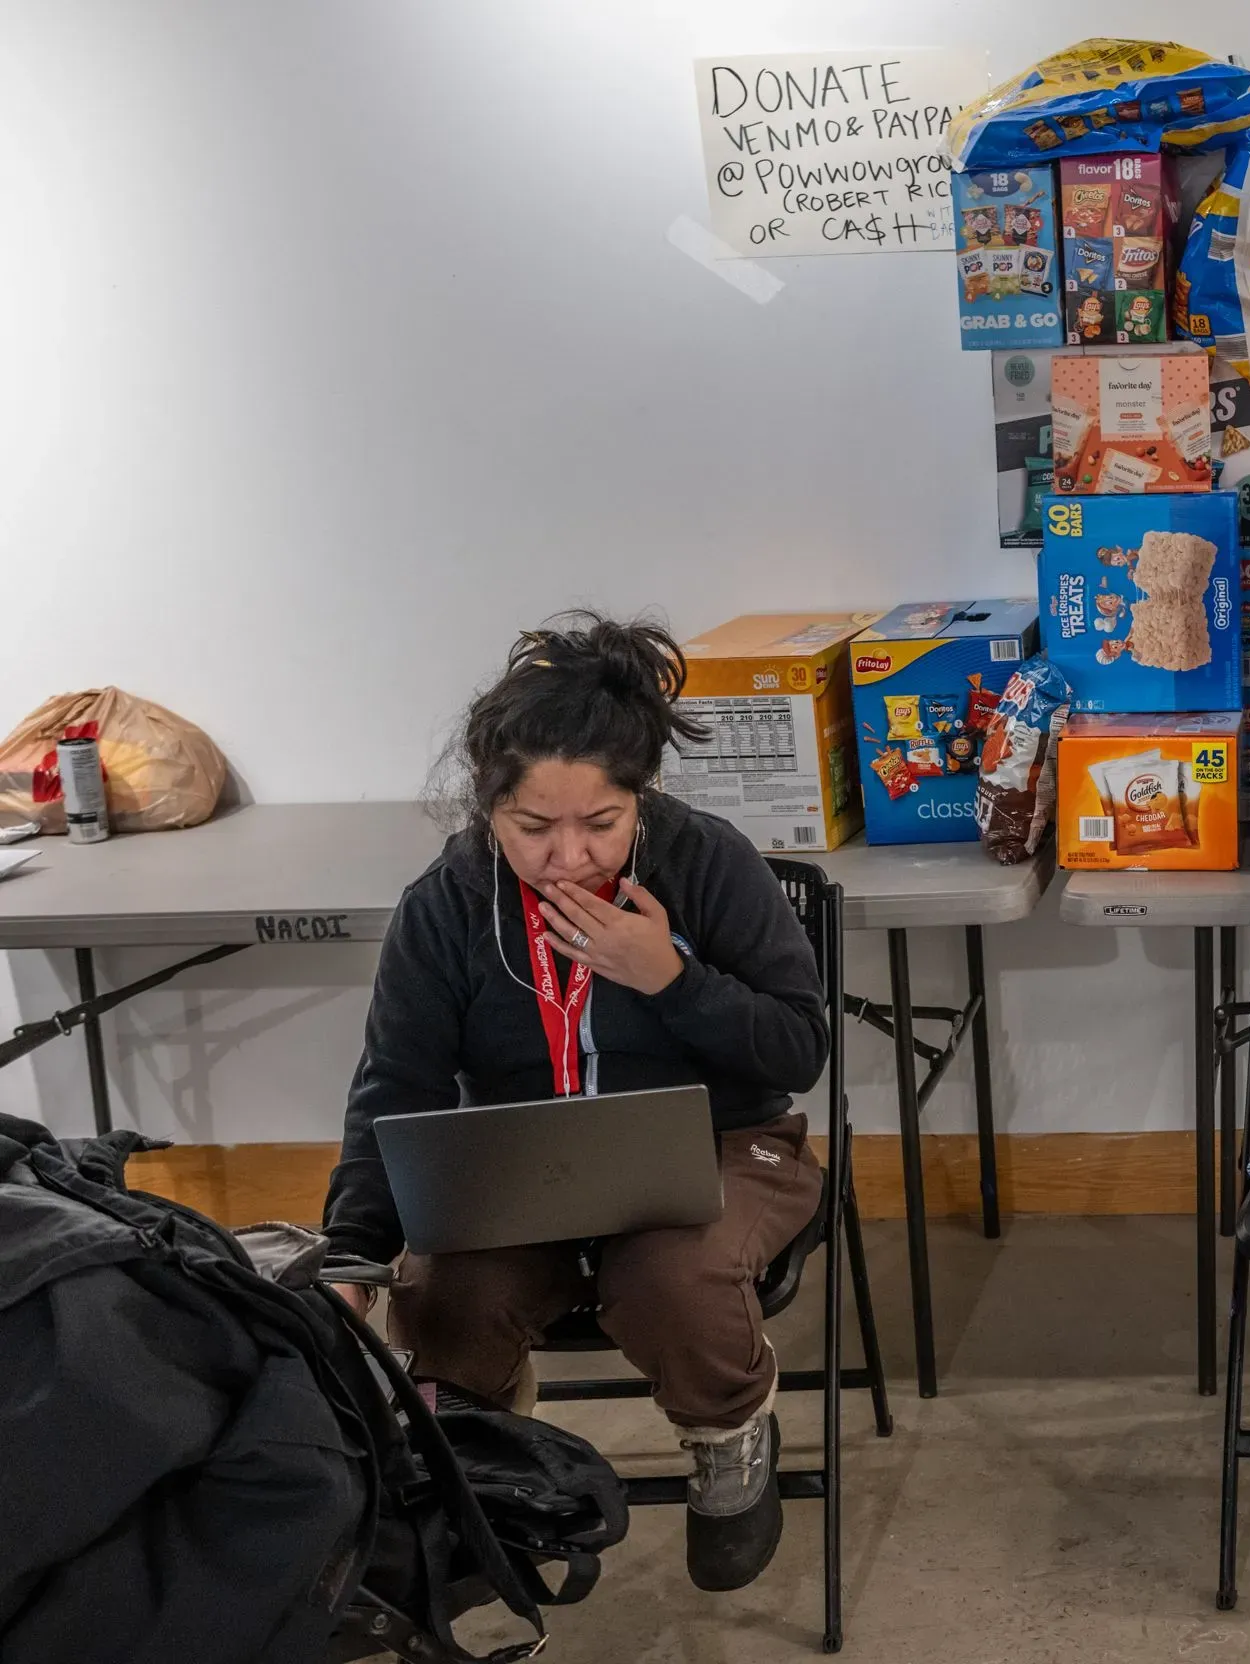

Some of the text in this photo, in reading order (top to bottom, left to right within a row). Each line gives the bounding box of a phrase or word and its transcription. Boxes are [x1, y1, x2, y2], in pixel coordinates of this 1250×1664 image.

[712, 62, 910, 117] DONATE
[872, 105, 963, 139] PAYPA
[1078, 158, 1134, 180] flavor 18
[990, 173, 1009, 187] 18
[783, 180, 951, 214] (ROBERT RIC
[1074, 189, 1105, 204] Cheetos
[1124, 193, 1151, 208] Doritos
[750, 213, 931, 245] OR CA$H
[1077, 247, 1106, 262] Doritos
[961, 312, 1058, 330] GRAB & GO
[1193, 318, 1206, 328] 18
[1109, 381, 1137, 390] favorite
[1062, 478, 1071, 486] 24
[1048, 504, 1070, 537] 60
[1070, 503, 1083, 537] BARS
[1059, 574, 1071, 638] RICE KRISPIES
[1069, 575, 1086, 636] TREATS
[1214, 578, 1228, 629] Original
[791, 667, 806, 680] 30
[1196, 750, 1224, 767] 45
[1196, 772, 1223, 780] PACKS
[1130, 783, 1162, 802] Goldfish
[1136, 811, 1166, 822] CHEDDAR
[1108, 906, 1142, 914] LIFETIME
[750, 1144, 781, 1160] Reebok
